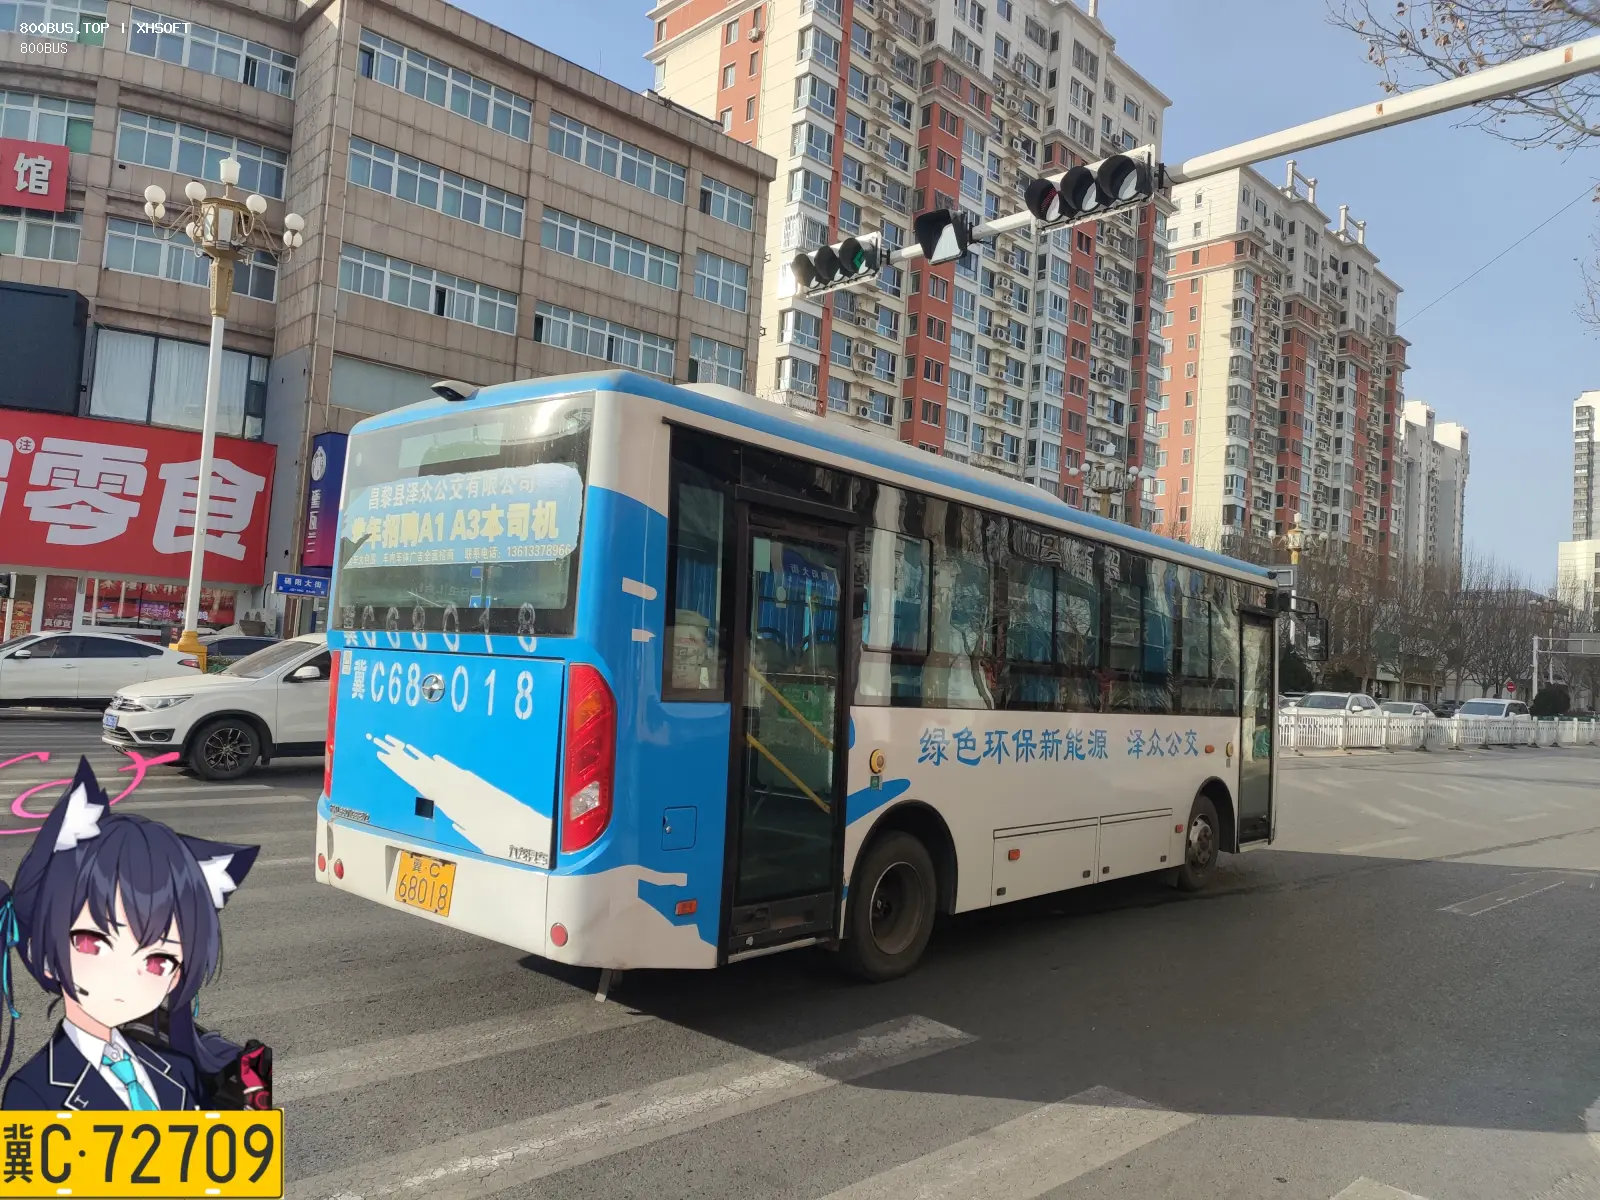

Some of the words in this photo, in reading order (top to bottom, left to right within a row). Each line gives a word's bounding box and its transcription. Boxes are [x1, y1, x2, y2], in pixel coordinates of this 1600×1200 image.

[13, 152, 53, 195] 馆
[23, 436, 266, 561] 零食
[368, 475, 537, 510] 昌黎县泽众公交有限公司
[450, 500, 560, 543] A3本司机
[917, 725, 1109, 767] 绿色环保新能源
[1126, 728, 1199, 760] 泽众公交
[398, 872, 448, 911] 68018
